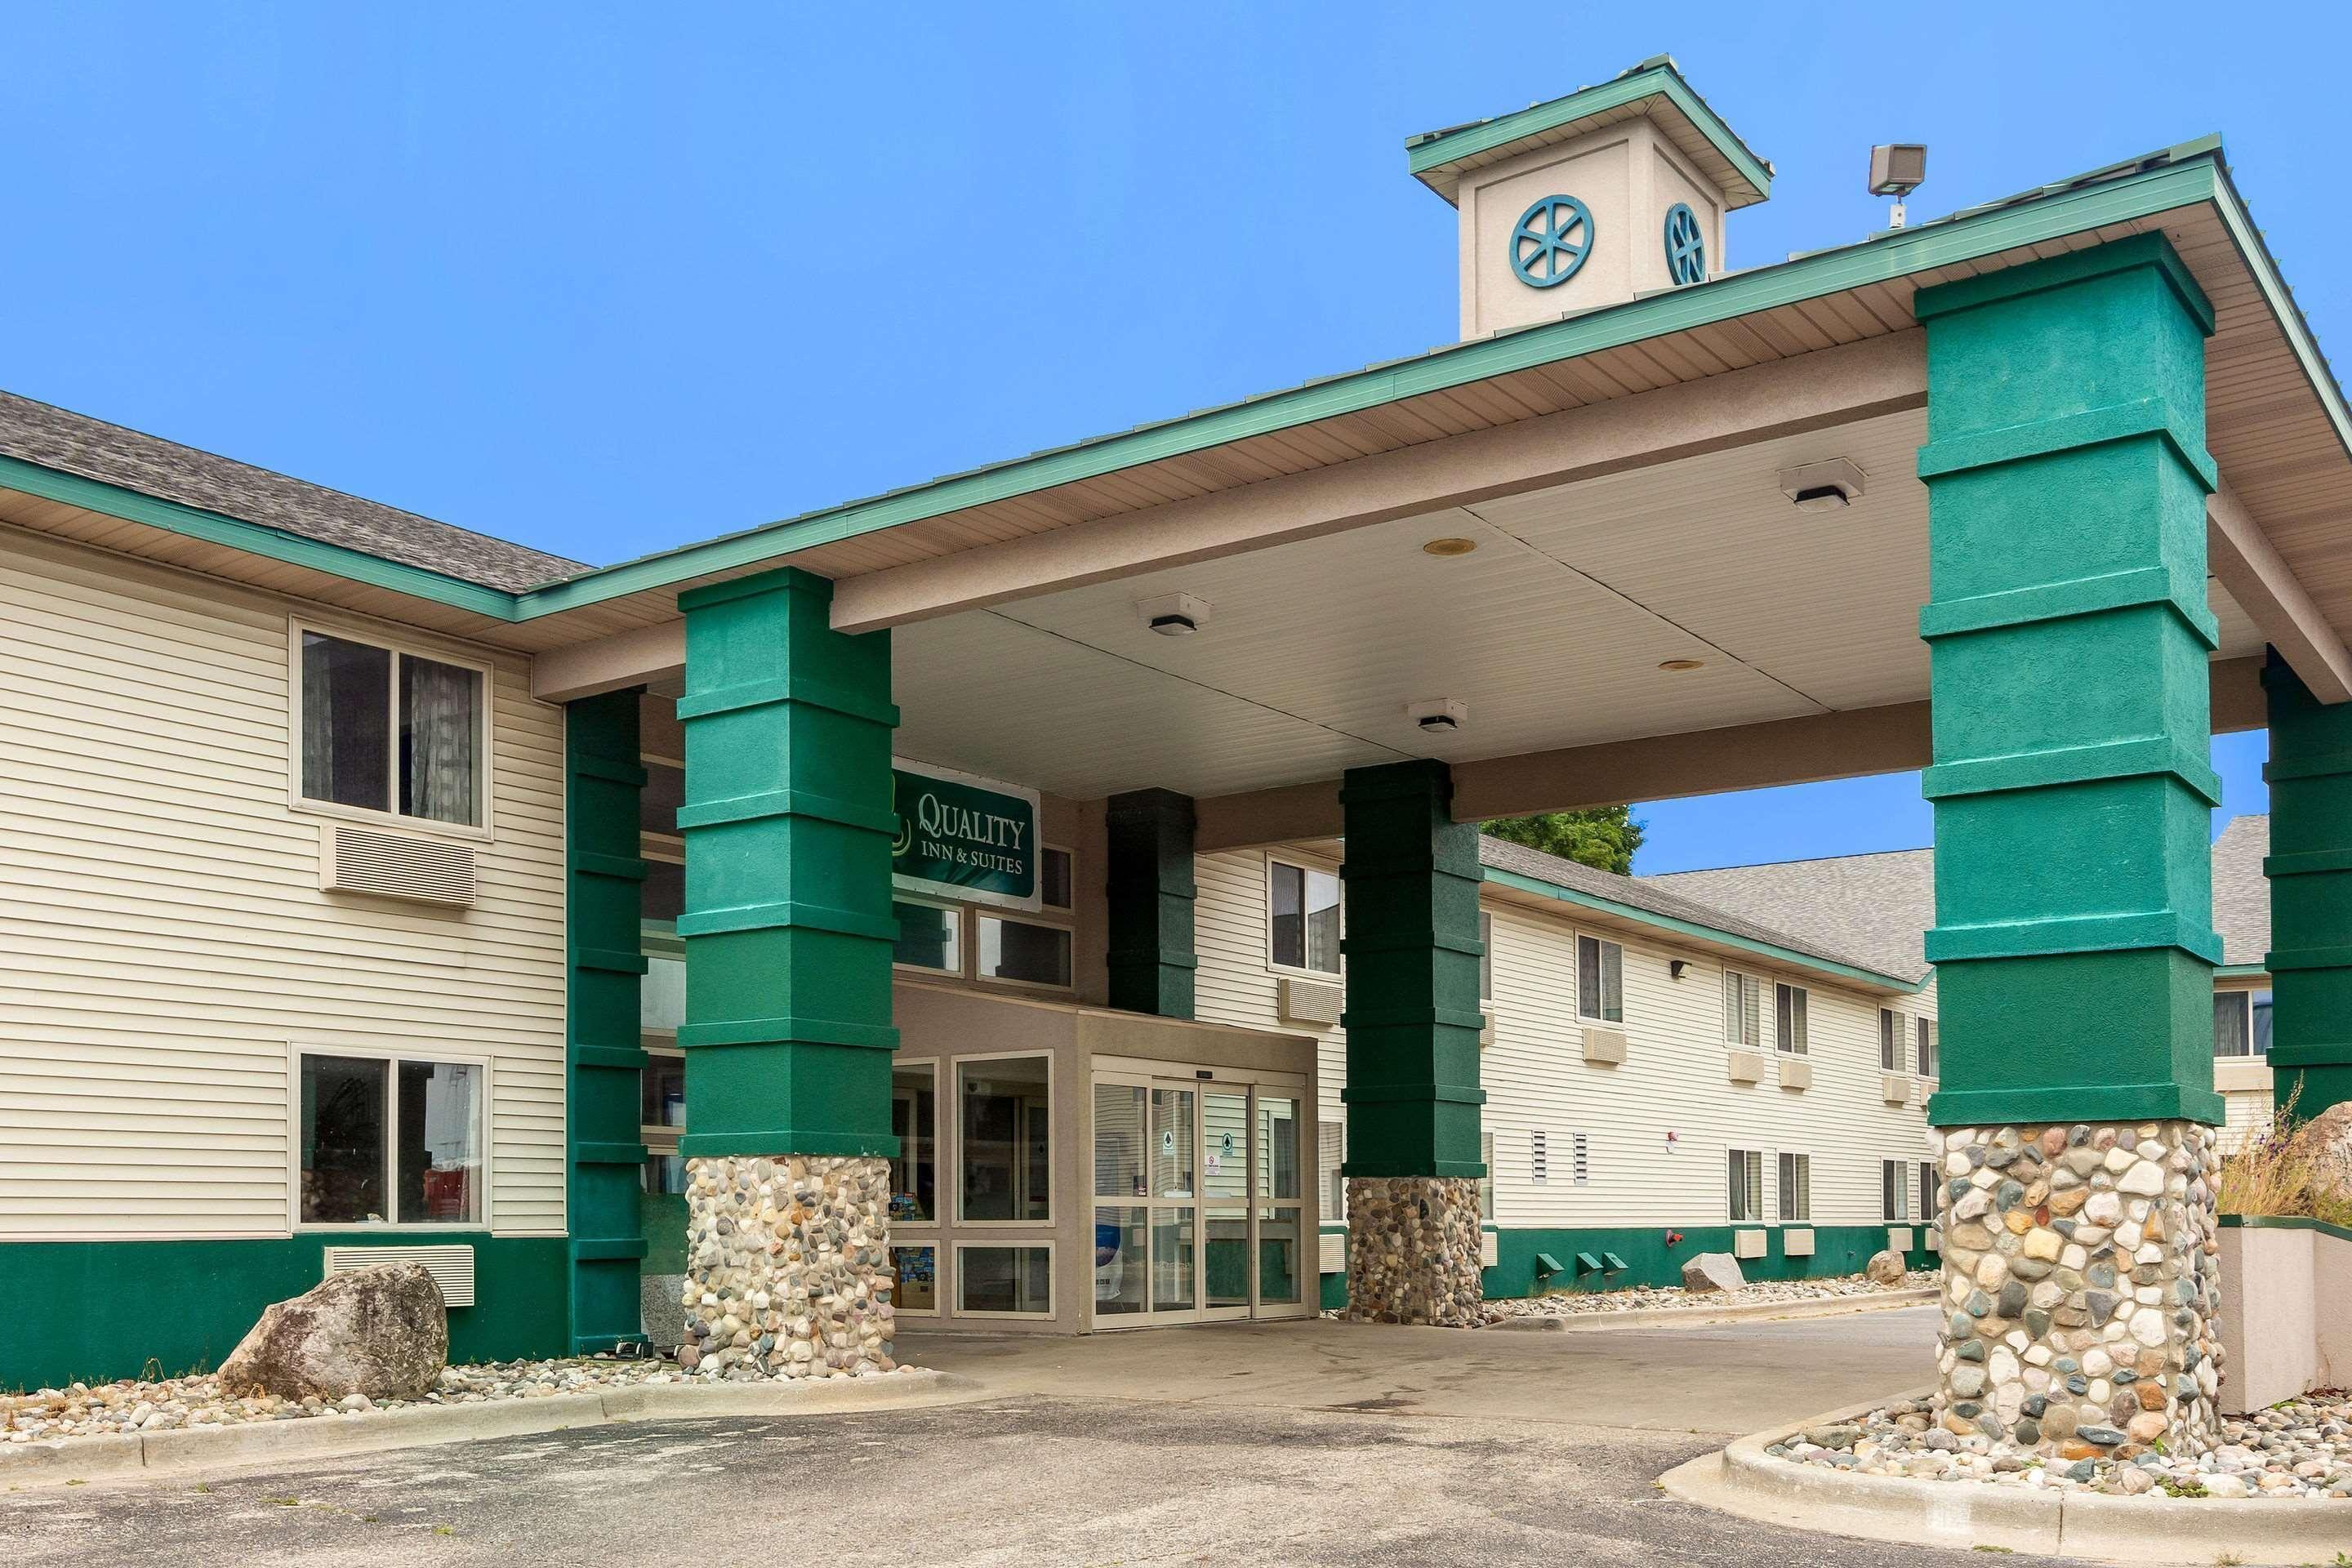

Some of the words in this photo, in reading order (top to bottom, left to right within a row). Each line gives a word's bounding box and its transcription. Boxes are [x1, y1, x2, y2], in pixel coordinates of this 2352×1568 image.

[919, 793, 1025, 849] QUALITY
[921, 840, 953, 861] INN
[956, 848, 967, 863] &
[970, 851, 1022, 874] SUITES
